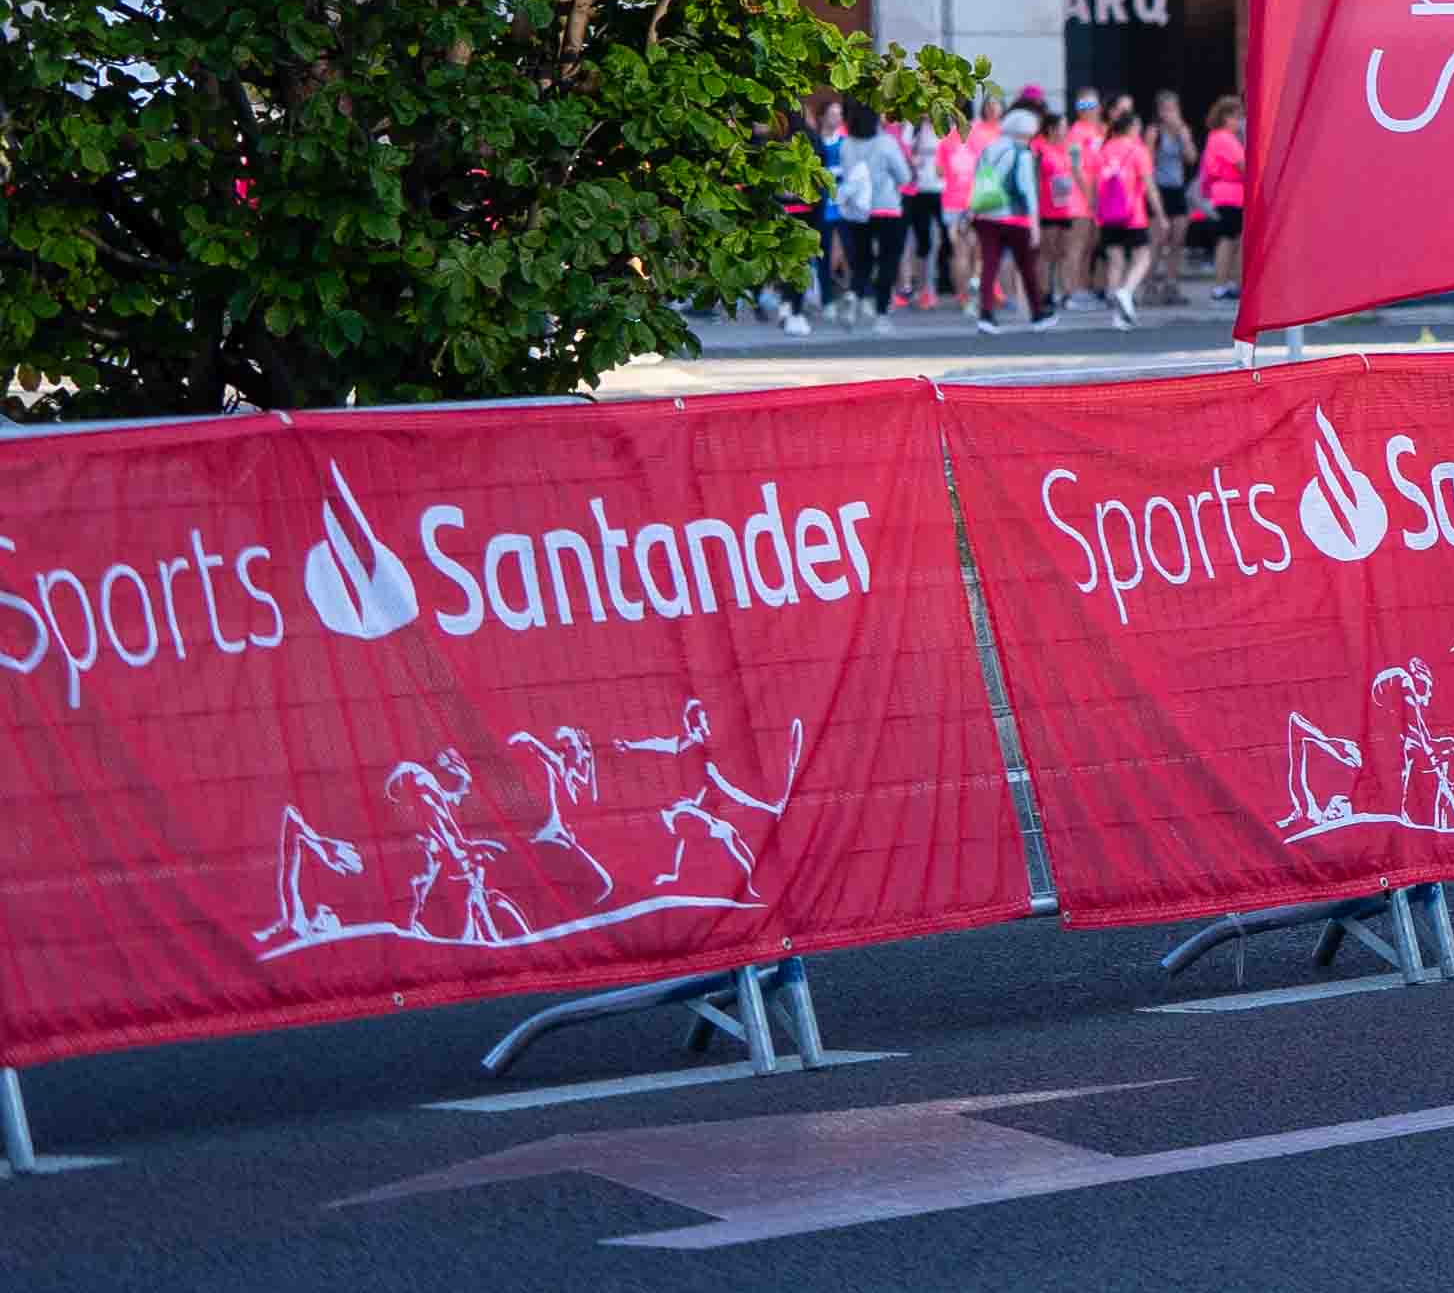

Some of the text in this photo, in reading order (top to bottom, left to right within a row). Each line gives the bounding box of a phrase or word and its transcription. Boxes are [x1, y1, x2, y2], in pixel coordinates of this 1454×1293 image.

[0, 482, 872, 708] Sports Santander
[1041, 466, 1293, 624] Sports
